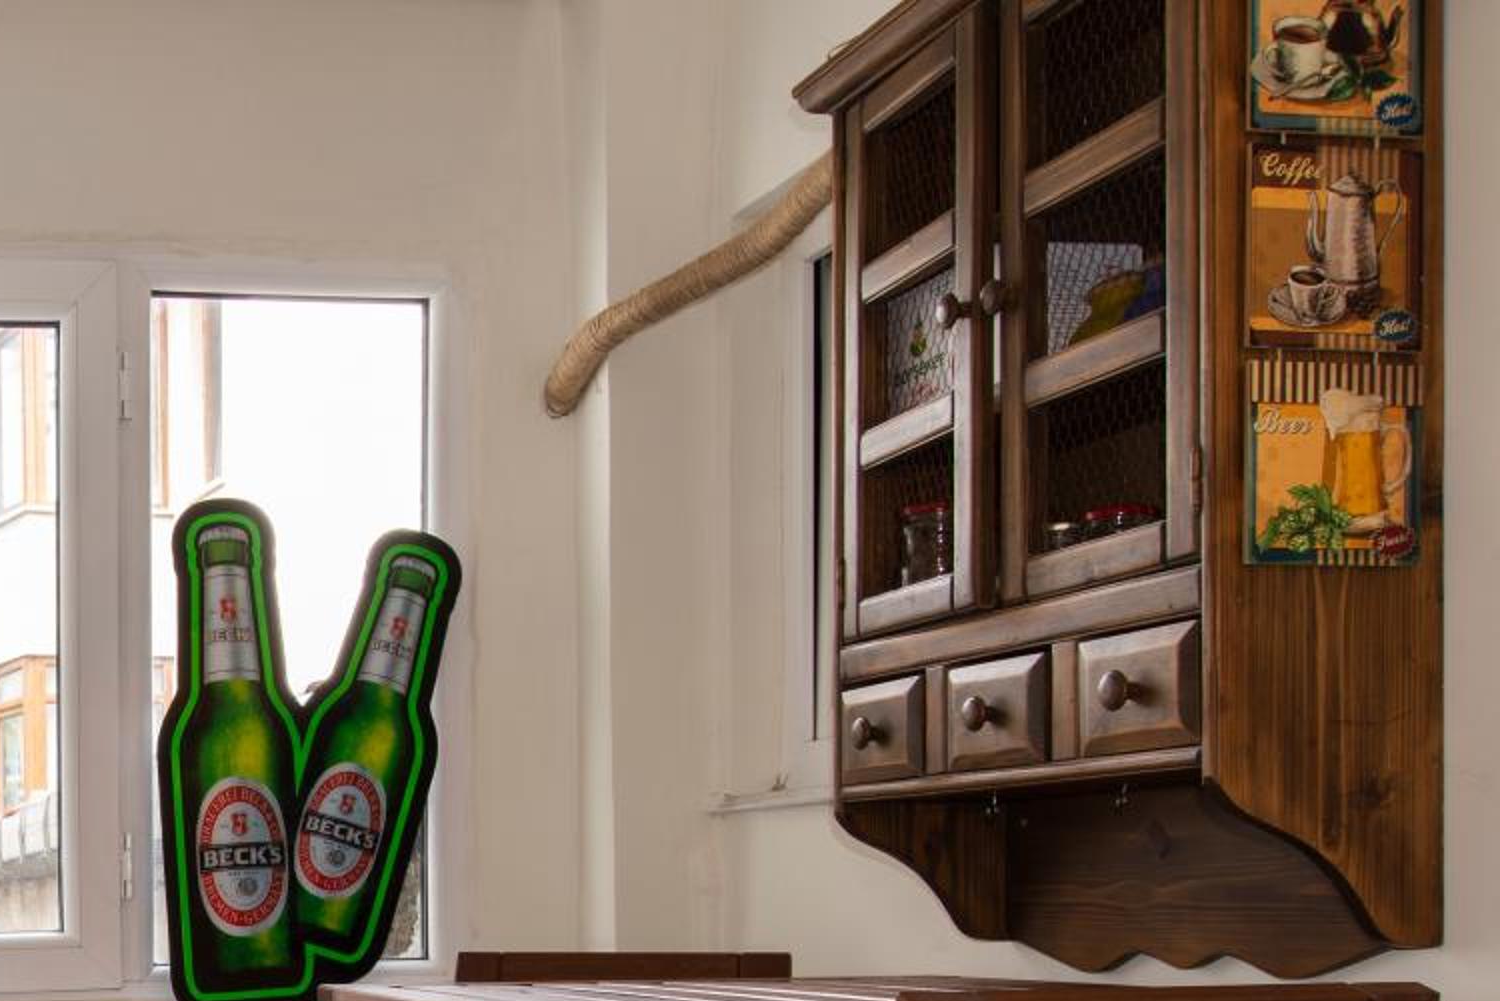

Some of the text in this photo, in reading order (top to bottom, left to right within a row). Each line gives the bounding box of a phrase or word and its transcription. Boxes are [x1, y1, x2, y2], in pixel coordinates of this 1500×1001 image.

[1258, 153, 1324, 186] Coffee
[307, 816, 374, 849] BECK'S
[203, 847, 282, 869] BECK'S
